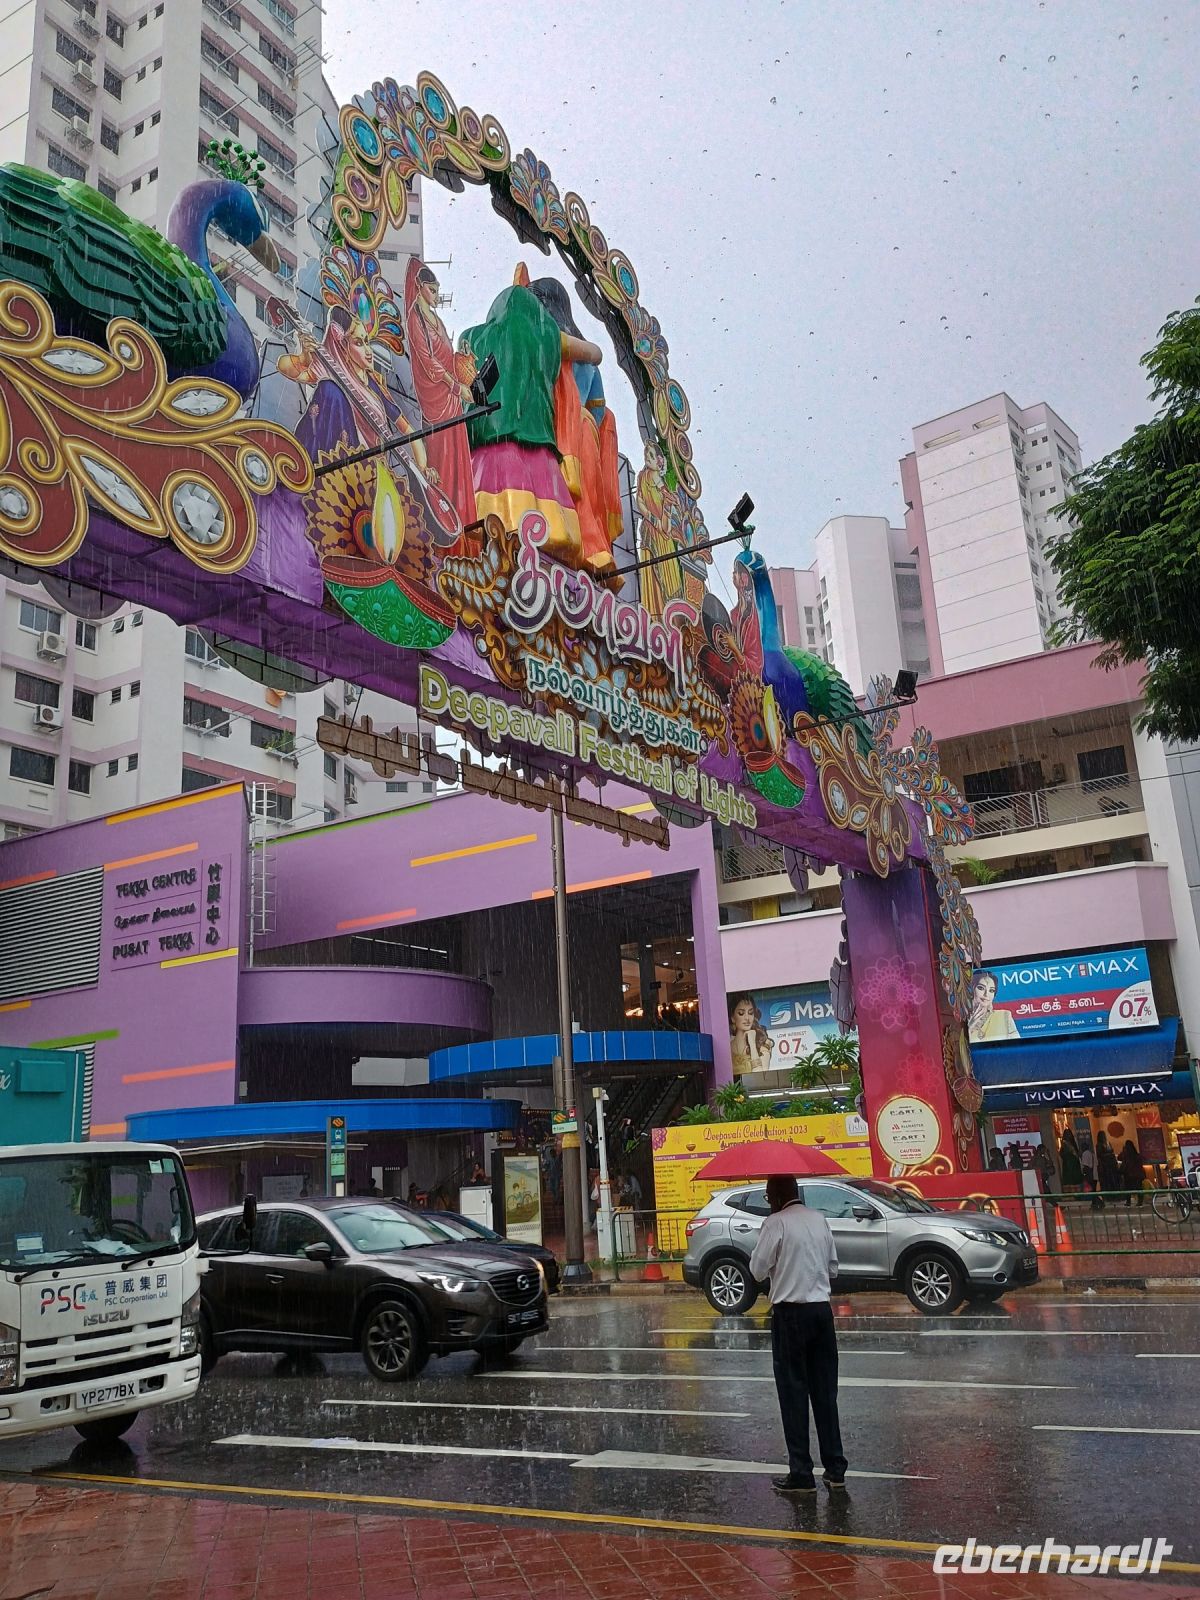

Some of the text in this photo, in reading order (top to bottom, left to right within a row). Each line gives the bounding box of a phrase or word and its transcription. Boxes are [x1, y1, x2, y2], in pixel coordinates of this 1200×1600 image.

[505, 510, 699, 699] தீபாவளி
[526, 653, 701, 755] நல்வாழ்த்துகள்
[419, 664, 757, 829] Deepavali Festival of Lights
[116, 867, 197, 898] TEKKA CENTRE
[112, 932, 195, 960] PUSAT TEKKA
[1002, 964, 1075, 986] MONEY
[1087, 956, 1139, 976] MAX
[1016, 997, 1105, 1015] அடகுக் கடை
[703, 1123, 808, 1144] Deepavali Celebation 2023
[104, 1274, 168, 1296] 普威集团
[40, 1283, 86, 1316] PSC
[104, 1297, 118, 1307] PSC
[119, 1293, 156, 1304] Corporation
[83, 1309, 130, 1327] ISUZU
[81, 1383, 135, 1405] YP277BX
